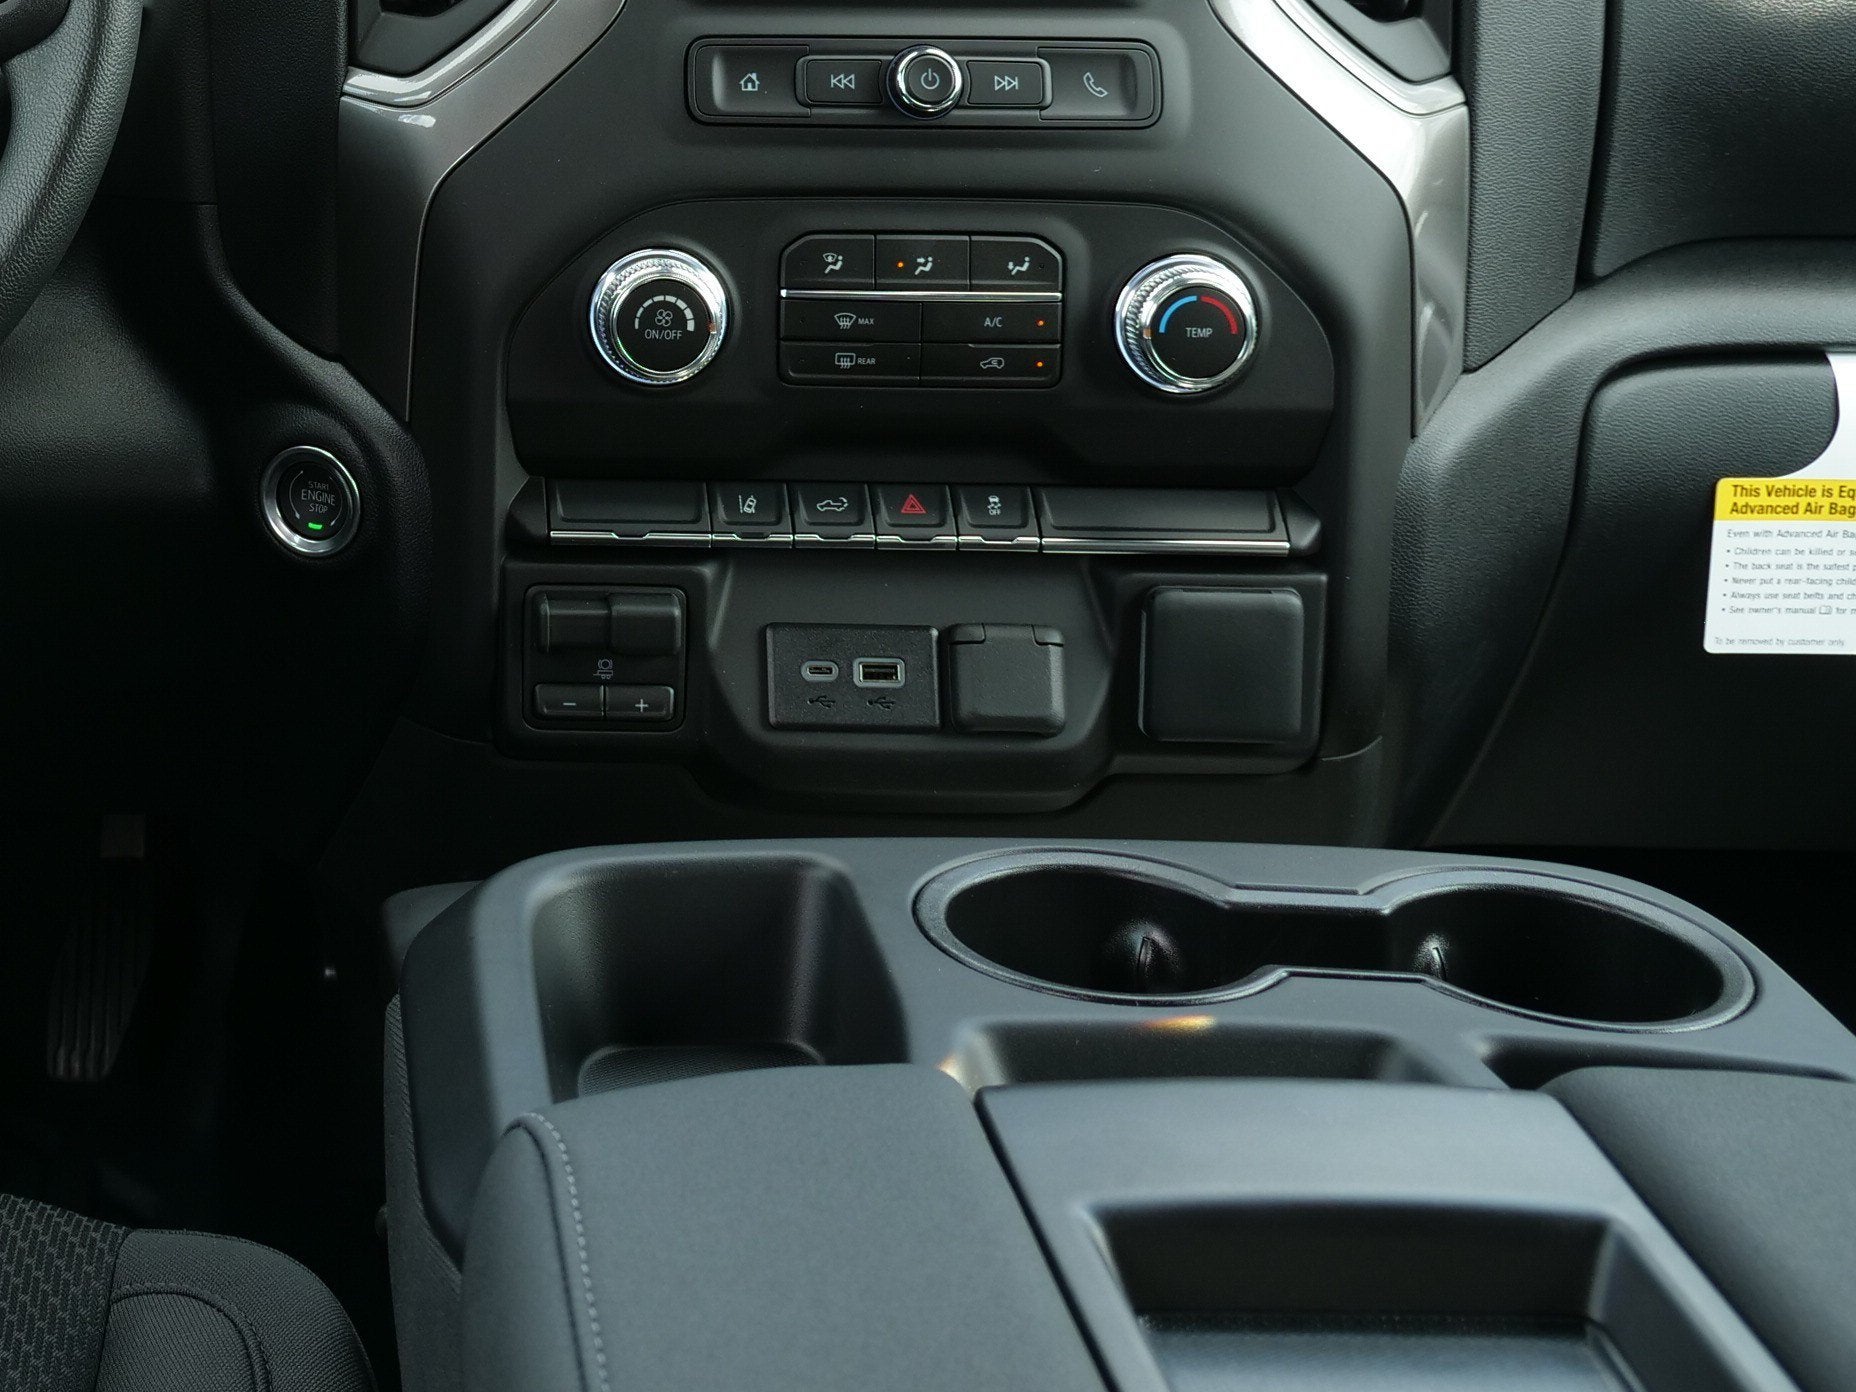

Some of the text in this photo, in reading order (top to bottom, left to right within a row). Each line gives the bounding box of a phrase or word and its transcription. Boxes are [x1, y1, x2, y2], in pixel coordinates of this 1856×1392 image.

[857, 317, 875, 326] MAX
[983, 316, 1003, 328] A/C
[644, 328, 683, 340] ON/OFF
[1185, 327, 1213, 338] TEMP
[857, 356, 876, 366] REAR
[301, 489, 336, 506] ENGINE
[1732, 484, 1761, 498] This
[1765, 484, 1817, 498] Vehicle
[1821, 484, 1834, 499] is
[308, 503, 329, 514] STOP
[1729, 502, 1799, 515] Advanced
[1803, 502, 1824, 515] Air
